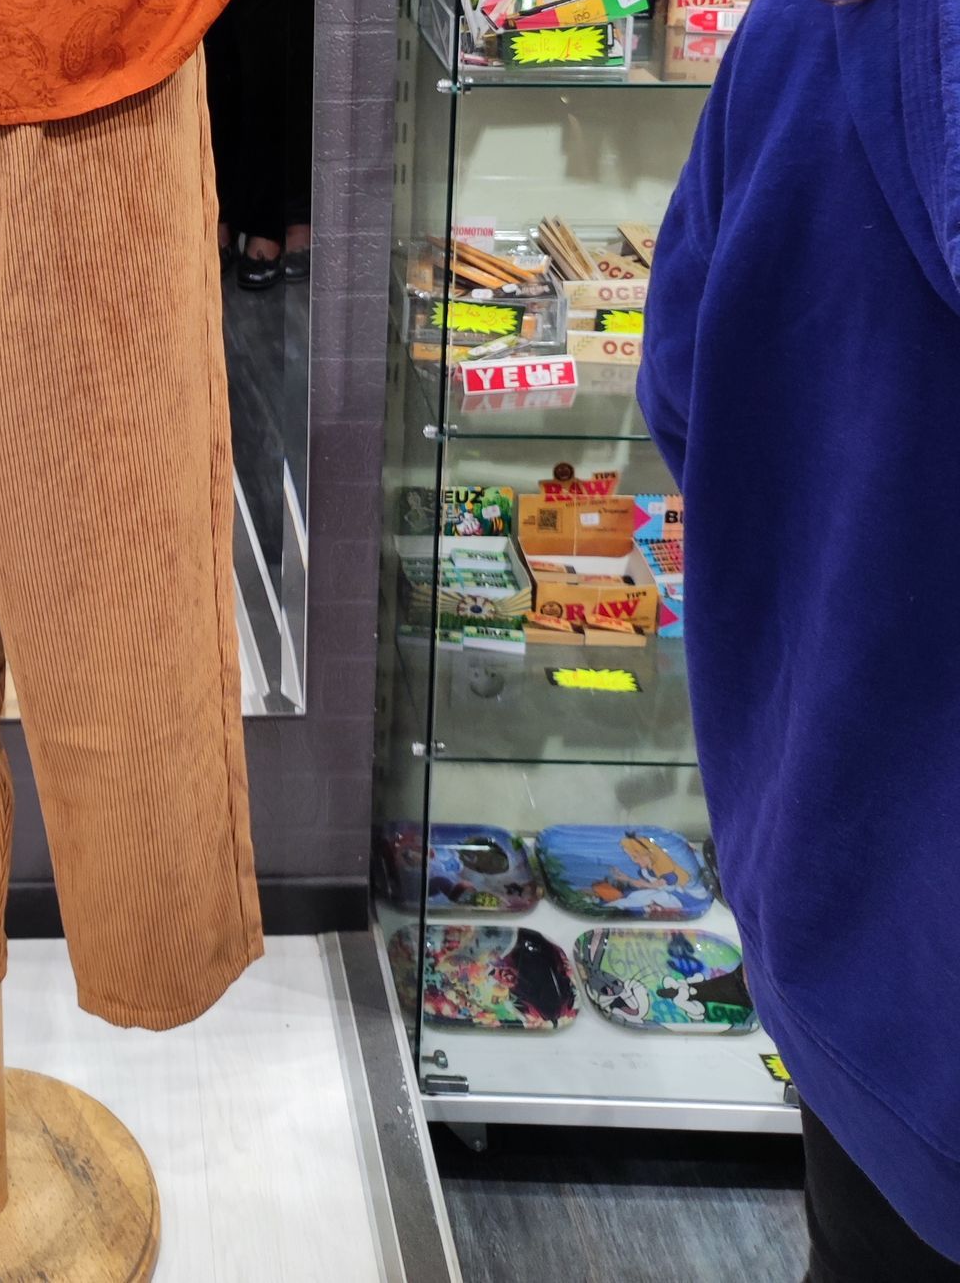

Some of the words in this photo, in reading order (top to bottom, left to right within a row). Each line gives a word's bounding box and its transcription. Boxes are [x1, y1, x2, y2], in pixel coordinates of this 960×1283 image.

[544, 482, 611, 501] RAW
[625, 591, 647, 600] TIPS
[565, 599, 641, 621] RAW
